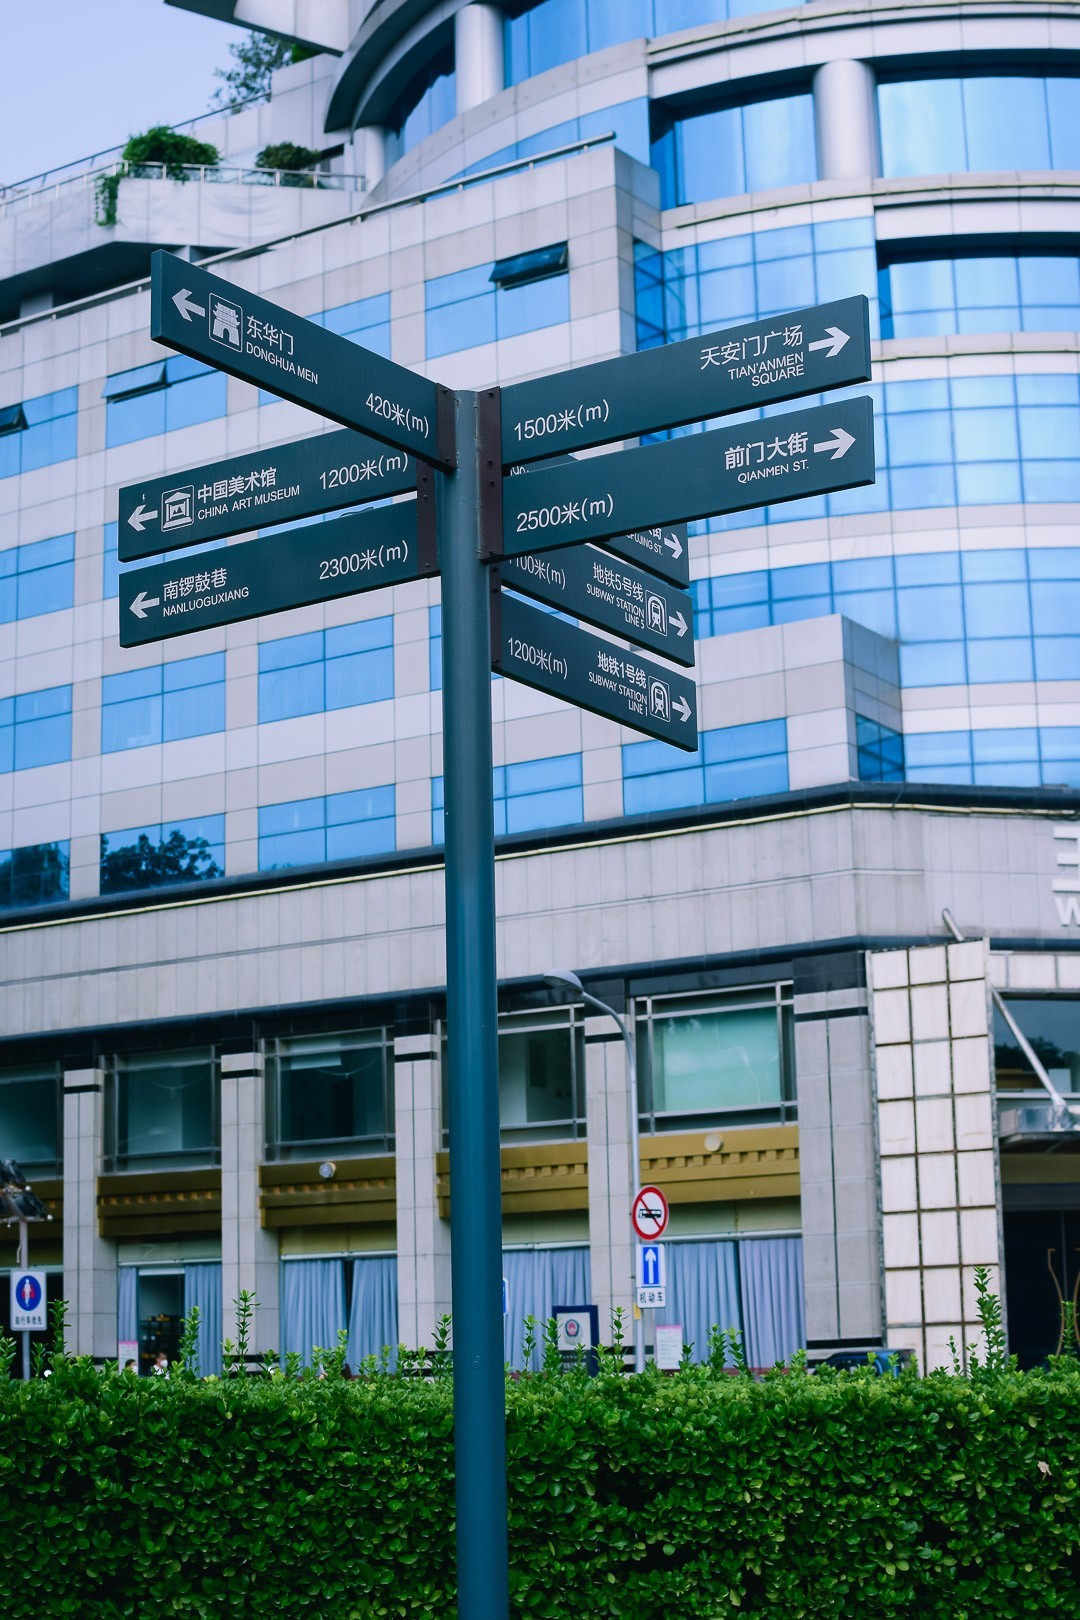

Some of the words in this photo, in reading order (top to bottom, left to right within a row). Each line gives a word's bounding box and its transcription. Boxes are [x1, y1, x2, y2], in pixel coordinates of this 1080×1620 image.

[246, 314, 294, 355] 东华门
[700, 325, 803, 370] 天安门广场
[246, 341, 296, 375] DONGHUA
[297, 365, 319, 385] MEN
[728, 352, 804, 380] TIAN'ANMEN
[751, 364, 804, 387] SQUARE
[366, 392, 429, 439] 420米(m)
[514, 399, 610, 441] 1500米(m)
[725, 431, 808, 470] 前门大街
[197, 467, 277, 503] 中国美术馆
[319, 452, 408, 490] 1200米(m)
[737, 463, 790, 484] QIANMEN
[792, 459, 809, 472] ST.
[197, 504, 229, 520] CHINA
[232, 496, 253, 512] ART
[254, 485, 300, 506] MUSEUM
[516, 493, 614, 532] 2500米(m)
[319, 540, 408, 580] 2300米(m)
[653, 543, 663, 555] ST.
[163, 567, 227, 602] 南锣鼓巷
[509, 555, 566, 590] 100米(m)
[592, 562, 643, 602] 地铁5号线
[163, 587, 249, 617] NANLUOGUXIANG
[586, 583, 614, 604] SUBWAY
[616, 597, 644, 618] STATION
[624, 612, 640, 627] LINE
[641, 619, 645, 629] 5
[507, 637, 568, 680] 1200米(m)
[597, 651, 646, 689] 地铁1号线
[588, 671, 617, 692] SUBWAY
[618, 684, 648, 705] STATION
[628, 700, 643, 715] LINE
[640, 1292, 663, 1303] 机动车
